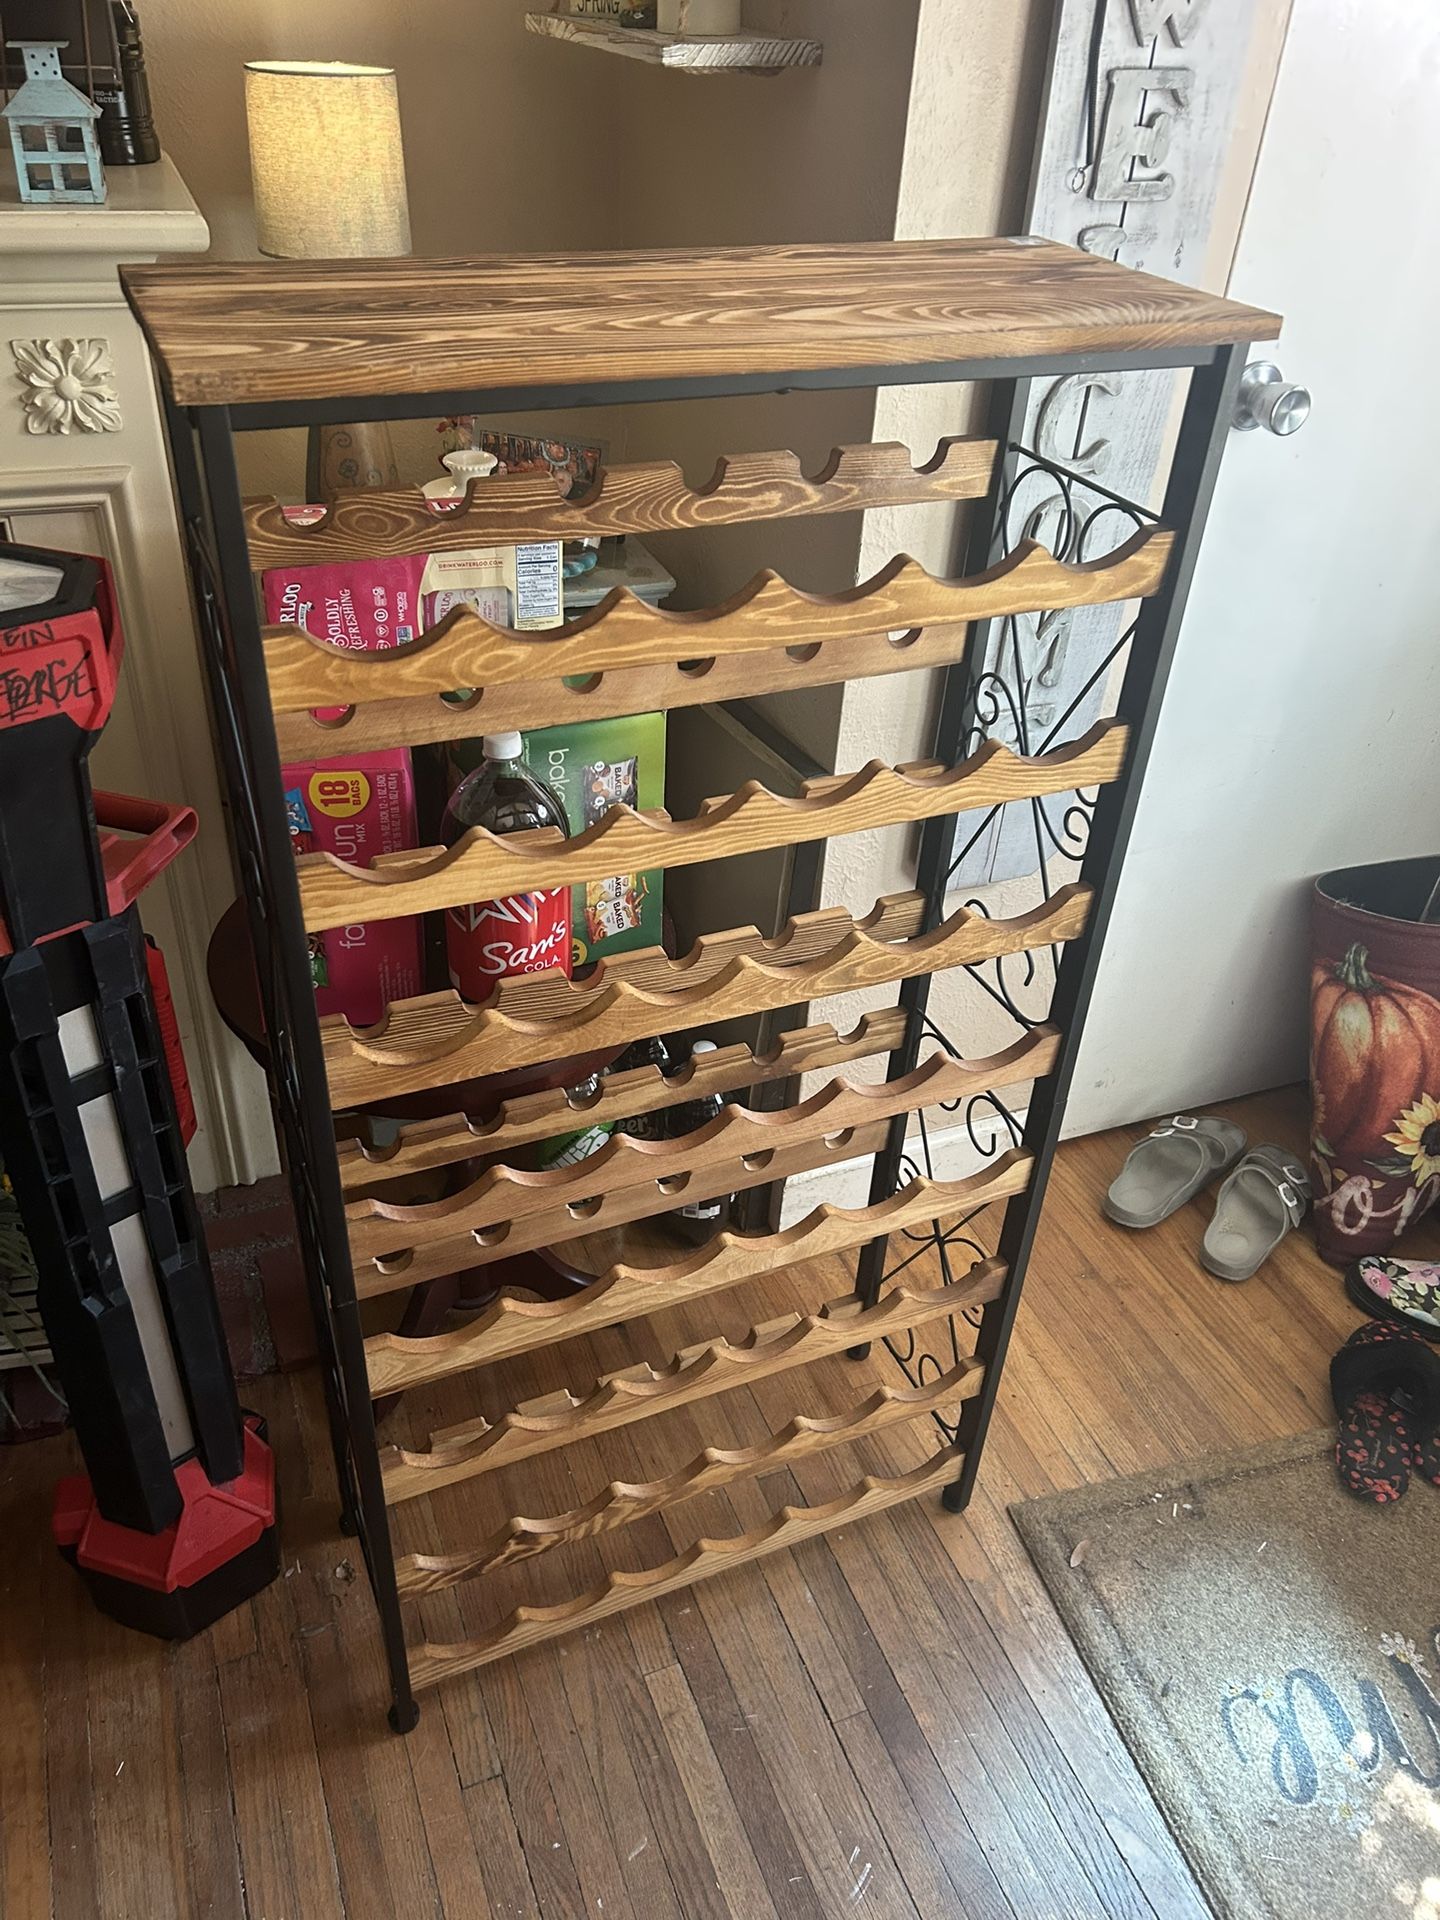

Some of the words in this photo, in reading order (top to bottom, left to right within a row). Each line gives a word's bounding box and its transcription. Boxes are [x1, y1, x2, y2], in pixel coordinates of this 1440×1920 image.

[440, 591, 454, 618] RLOO
[325, 597, 350, 649] BOLDLY
[318, 780, 351, 808] 18
[350, 779, 362, 806] BAGS
[614, 766, 622, 797] BAKED
[334, 823, 359, 864] un
[355, 823, 367, 843] MIX
[614, 876, 622, 898] AKED
[612, 901, 625, 929] BAKED
[478, 919, 566, 975] Sam's
[524, 954, 561, 973] COLA
[616, 1116, 649, 1134] eer
